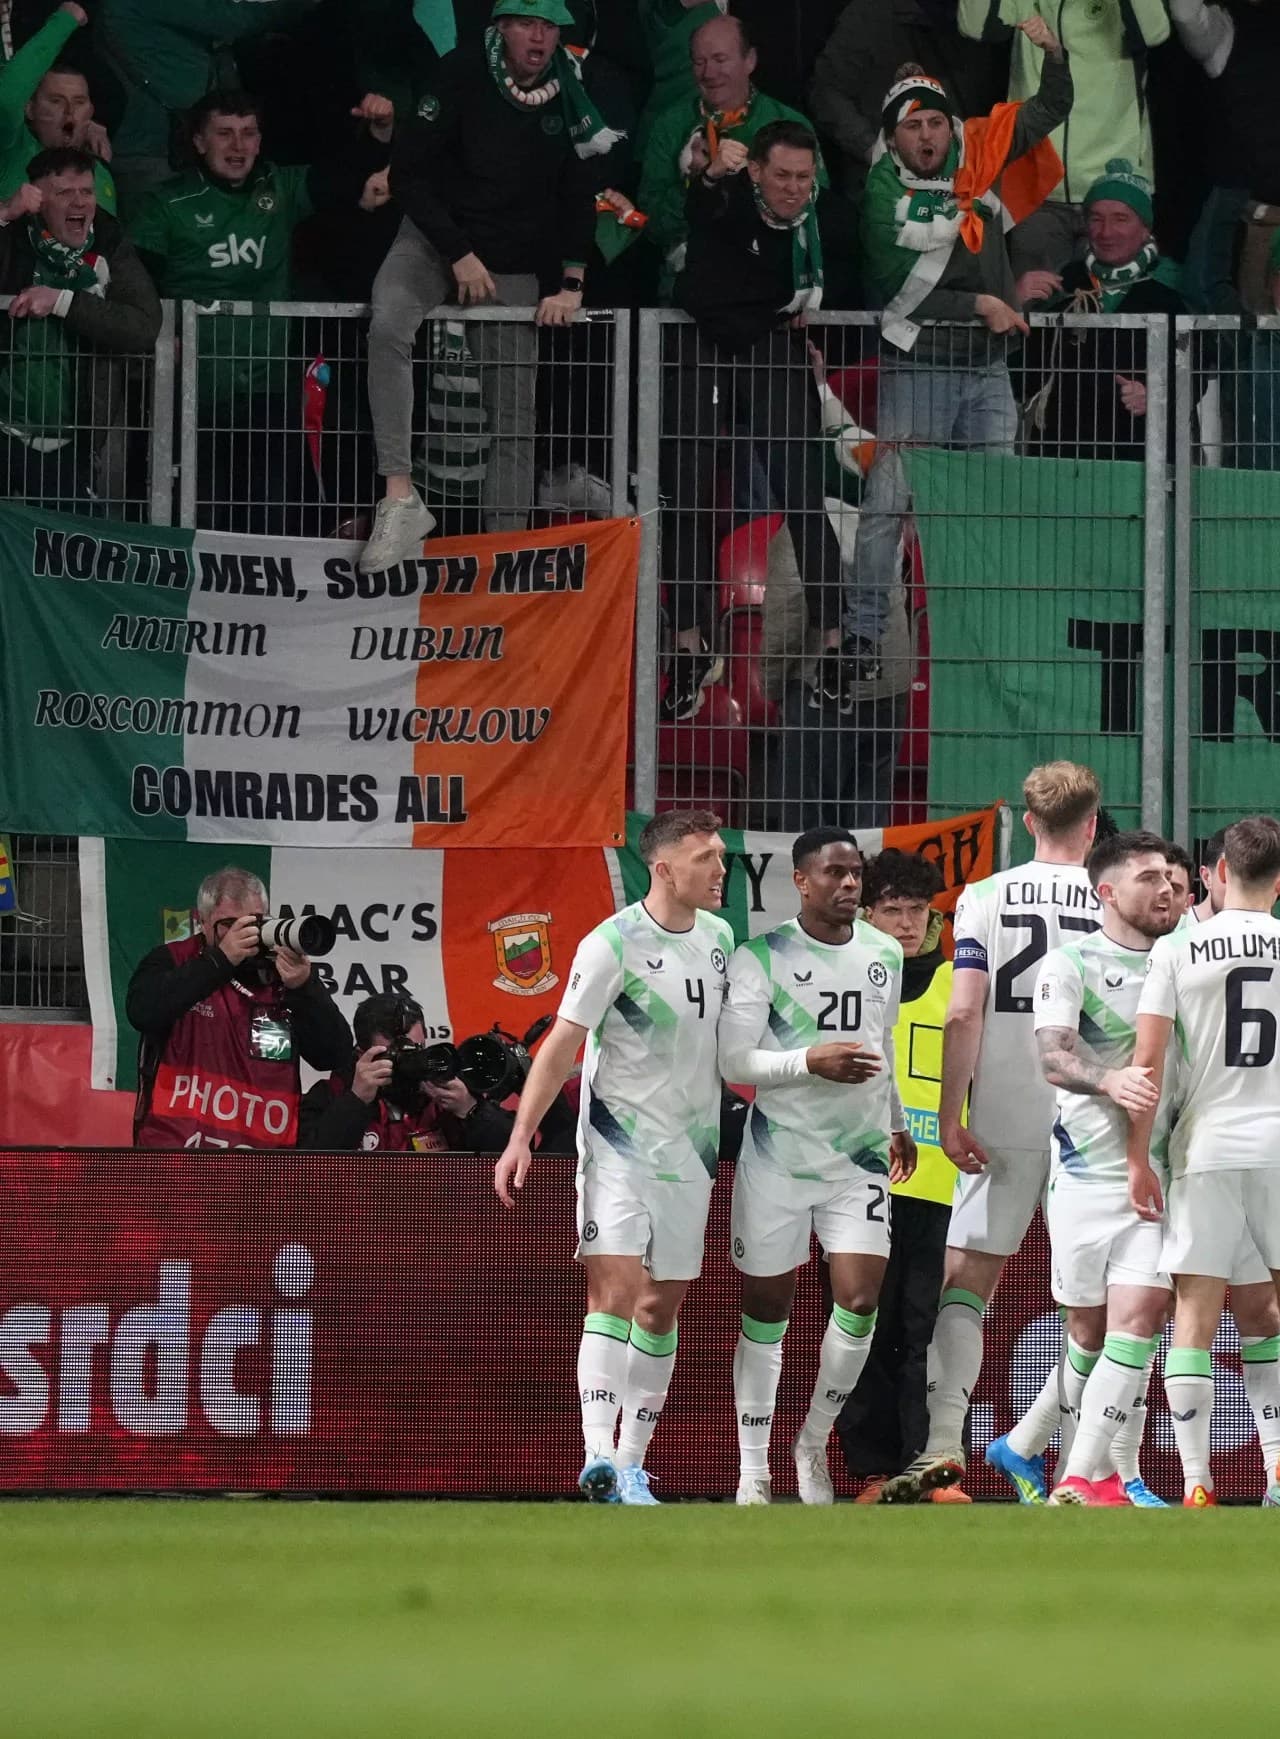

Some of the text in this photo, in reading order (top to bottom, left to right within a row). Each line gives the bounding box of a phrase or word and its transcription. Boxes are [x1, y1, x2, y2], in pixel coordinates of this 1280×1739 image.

[207, 232, 267, 270] sky
[33, 528, 588, 603] NORTH MEN, SOUTH MEN
[130, 763, 469, 825] COMRADES ALL
[1006, 881, 1101, 910] COLLINS
[685, 978, 705, 1019] 4
[817, 990, 862, 1031] 20
[1225, 966, 1277, 1067] 6
[169, 1074, 290, 1135] PHOTO
[0, 1243, 314, 1437] srdci
[582, 1388, 616, 1405] ÉIRE
